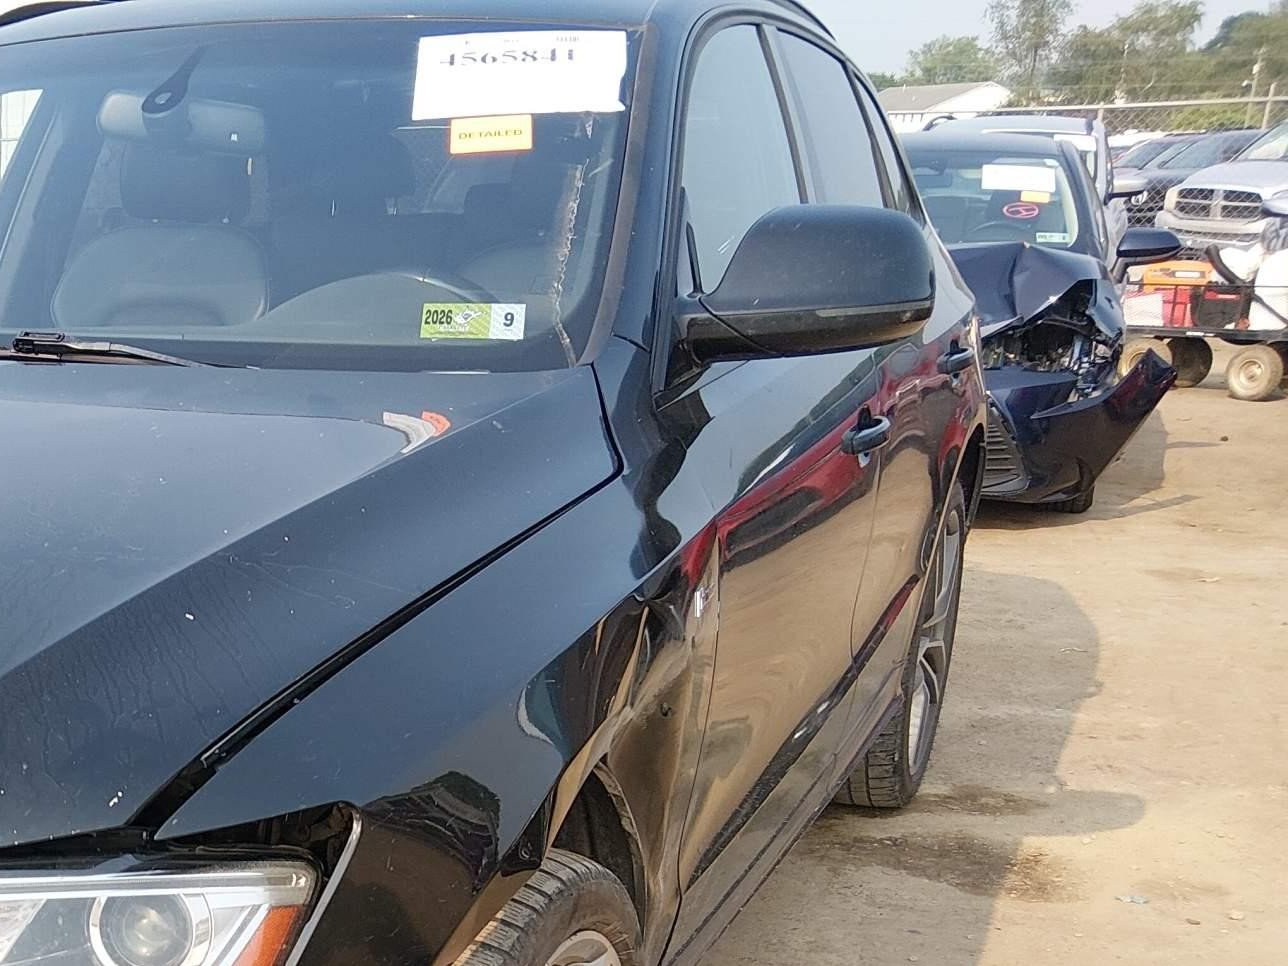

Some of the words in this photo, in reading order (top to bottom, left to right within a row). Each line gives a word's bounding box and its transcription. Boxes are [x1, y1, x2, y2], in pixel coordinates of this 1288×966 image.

[458, 129, 523, 140] DETAILED
[424, 309, 453, 325] 2026
[503, 312, 514, 327] 9
